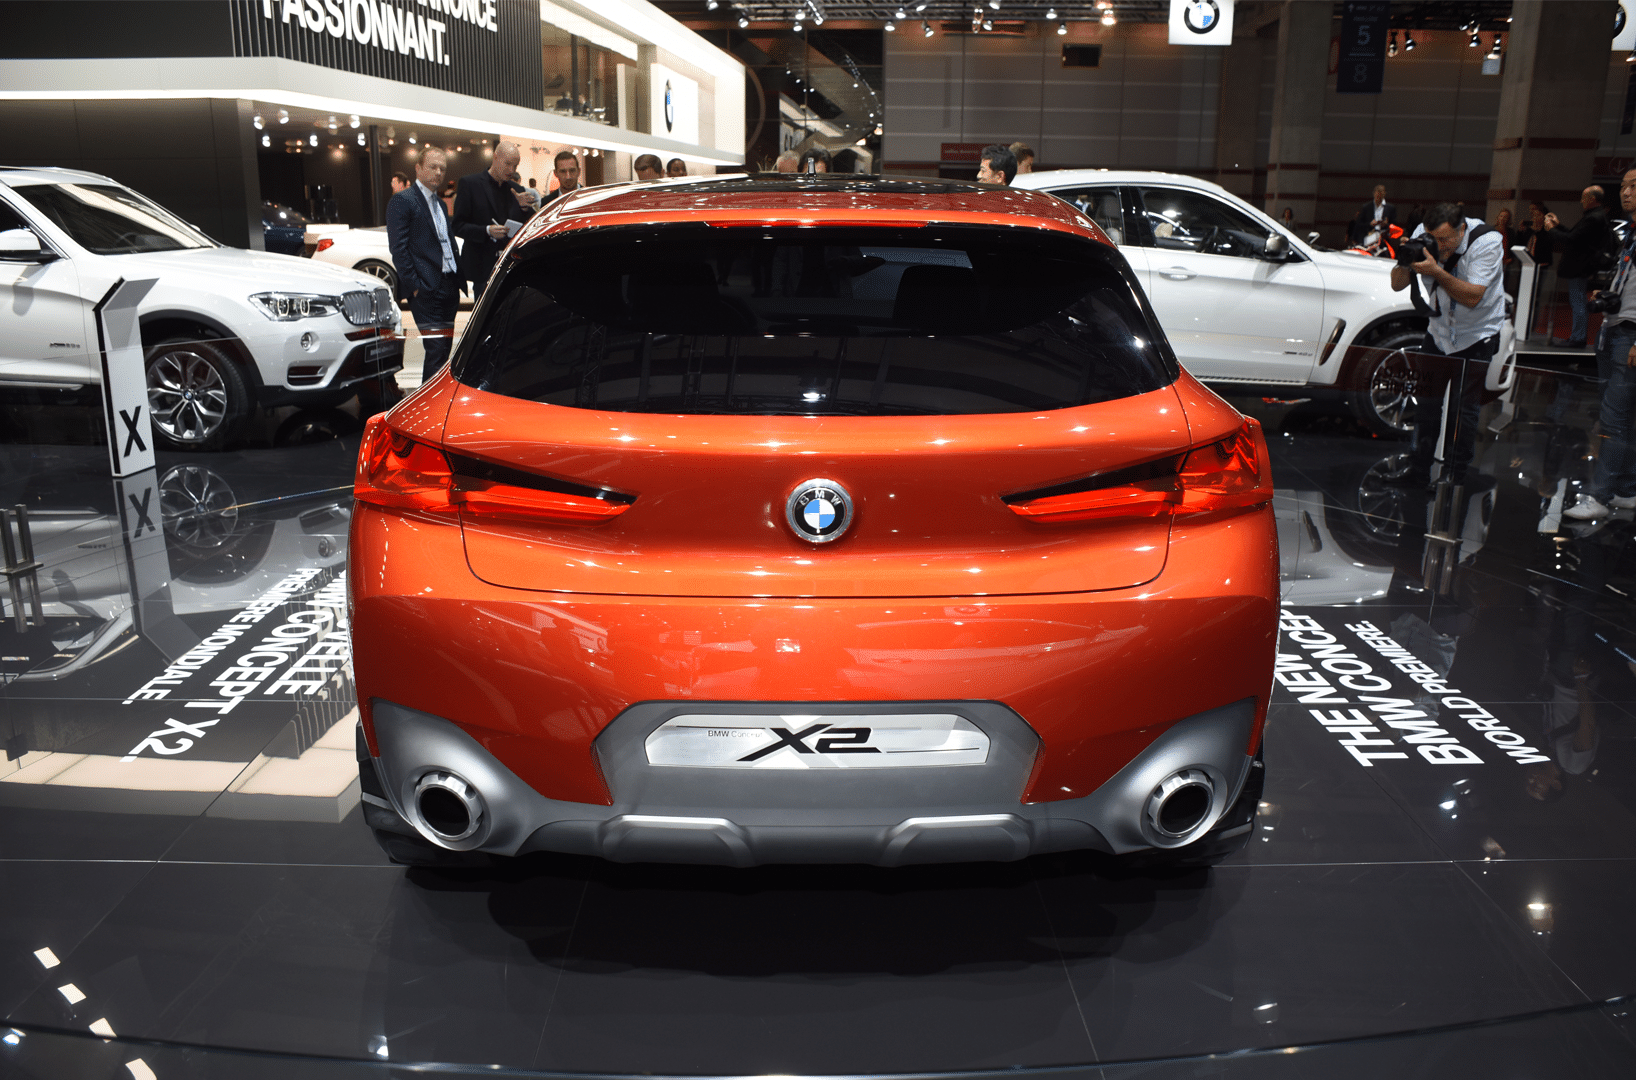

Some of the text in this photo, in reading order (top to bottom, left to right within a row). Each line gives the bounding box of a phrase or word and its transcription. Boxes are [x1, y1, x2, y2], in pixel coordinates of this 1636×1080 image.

[119, 405, 147, 458] X
[799, 489, 841, 506] BMW
[122, 624, 253, 705] MONDIALE.
[184, 610, 334, 715] CONCEPT
[1280, 601, 1485, 765] BMW CONCEP
[1344, 620, 1551, 765] WORLD PREMIERE.
[119, 717, 221, 763] X2.
[707, 730, 763, 738] BMW Concp
[736, 723, 883, 762] X2
[1274, 653, 1409, 767] THE NEW
